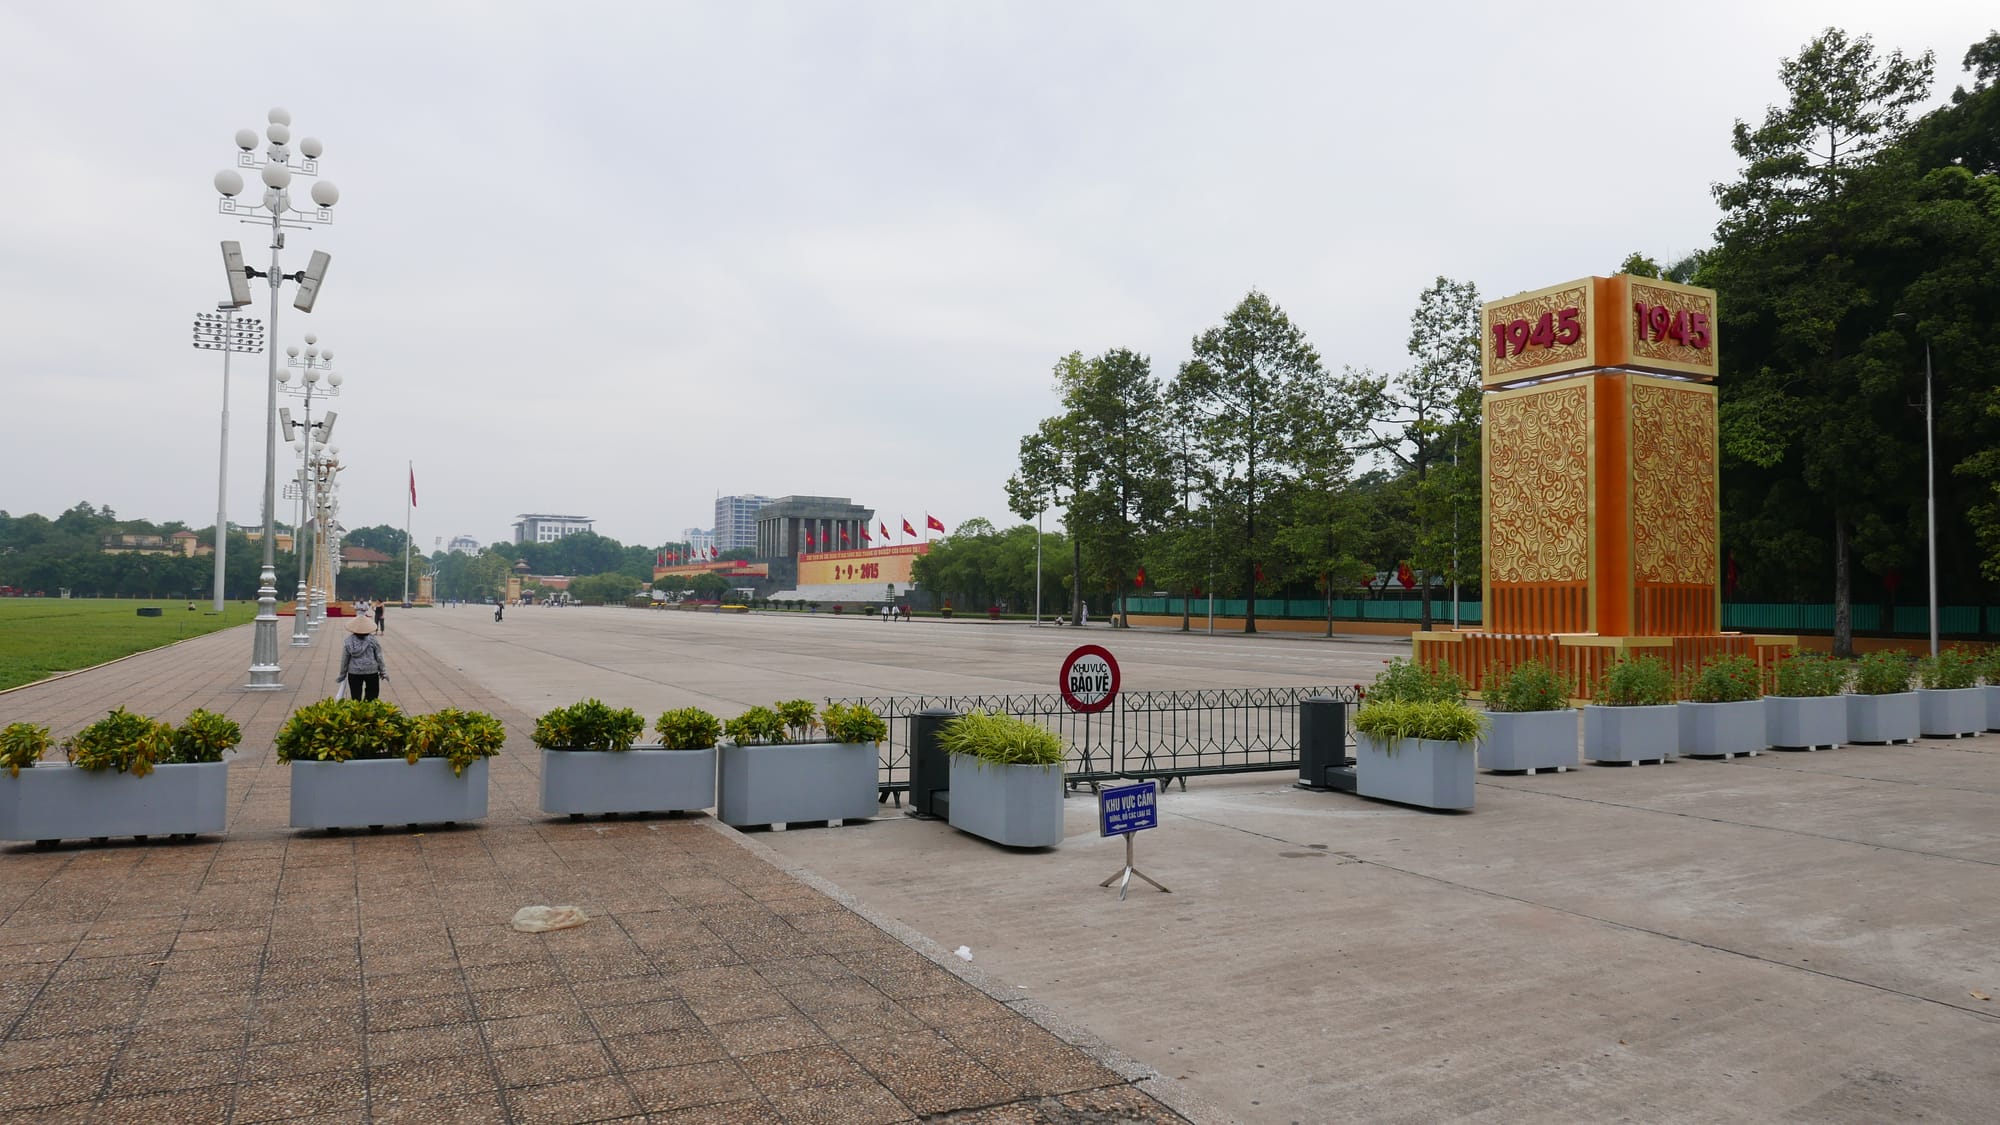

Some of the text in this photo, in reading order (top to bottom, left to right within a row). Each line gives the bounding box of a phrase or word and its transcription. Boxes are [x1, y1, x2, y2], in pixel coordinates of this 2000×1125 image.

[1492, 308, 1578, 358] 1945
[1635, 303, 1710, 349] 1945
[835, 564, 840, 580] 2
[847, 564, 853, 580] 9
[860, 563, 879, 579] 2015
[1072, 663, 1090, 673] KHU
[1071, 672, 1109, 695] BẢO VỆ
[1105, 789, 1154, 813] KHU VỰC CẤM
